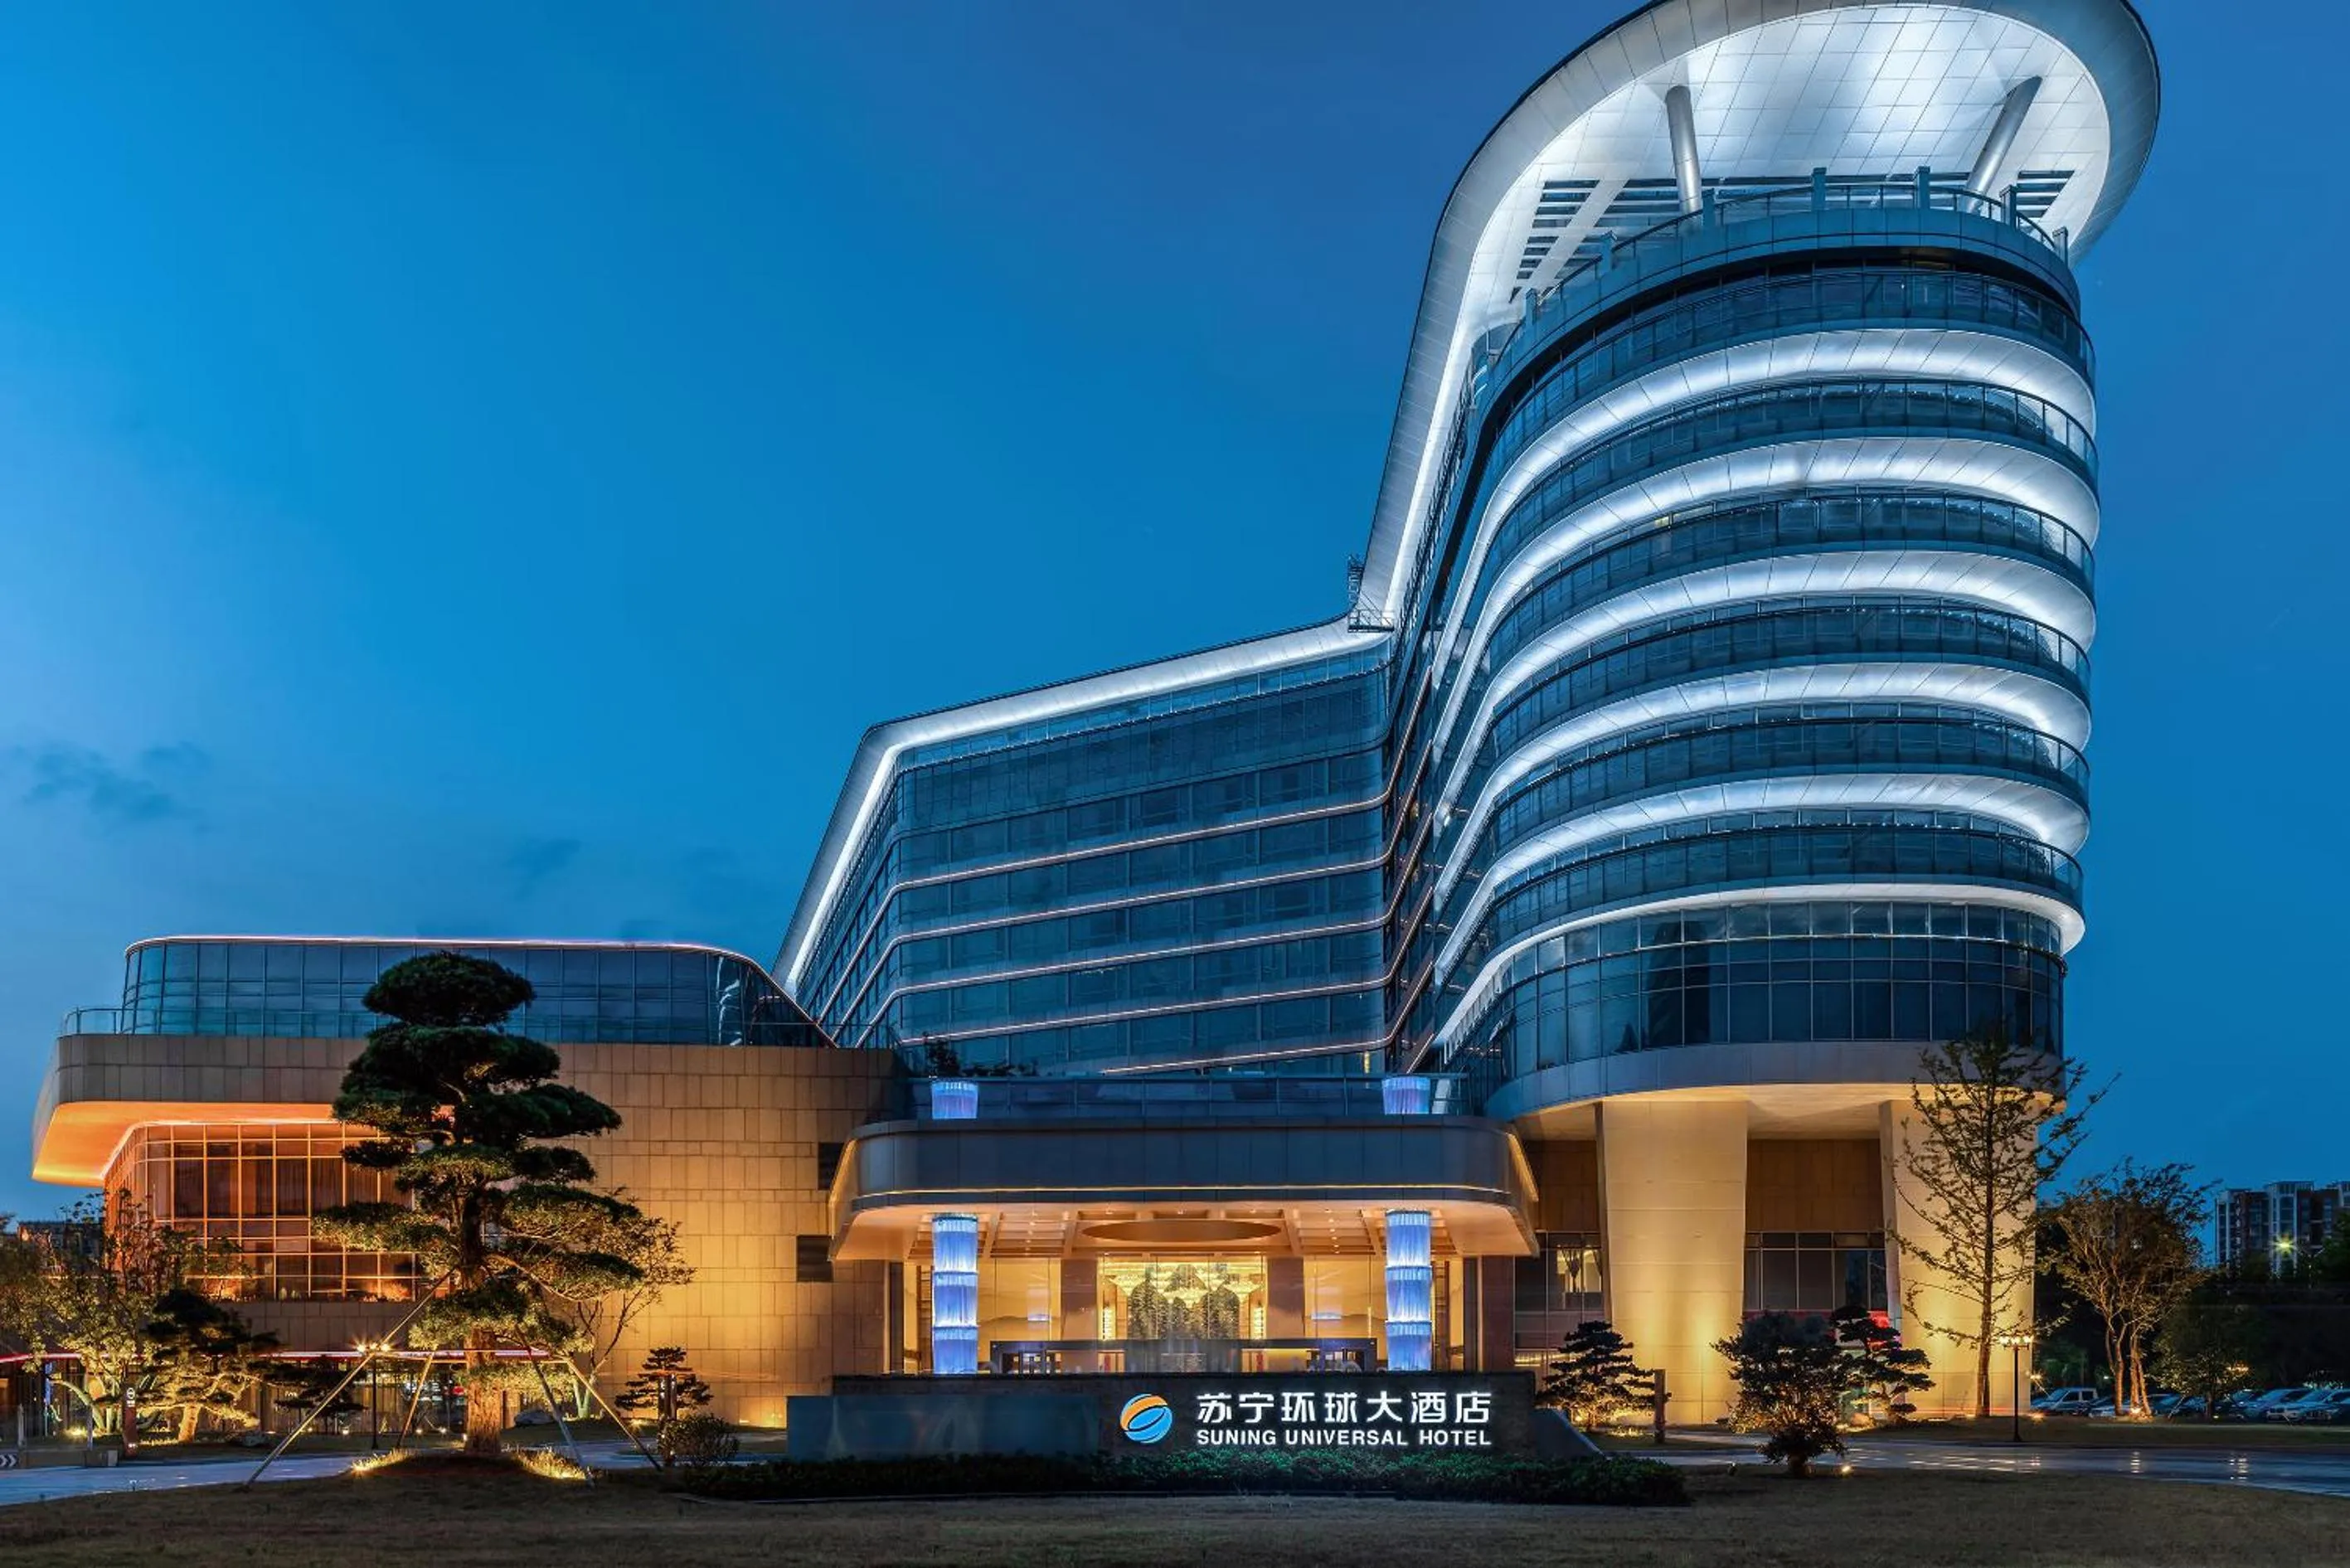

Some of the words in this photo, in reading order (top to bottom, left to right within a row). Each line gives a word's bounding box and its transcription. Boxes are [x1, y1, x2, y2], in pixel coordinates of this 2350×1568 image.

[1196, 1390, 1493, 1424] 苏宁环球大酒店
[1196, 1429, 1277, 1446] SUNING
[1284, 1429, 1409, 1446] UNIVERSAL
[1418, 1429, 1492, 1446] HOTEL
